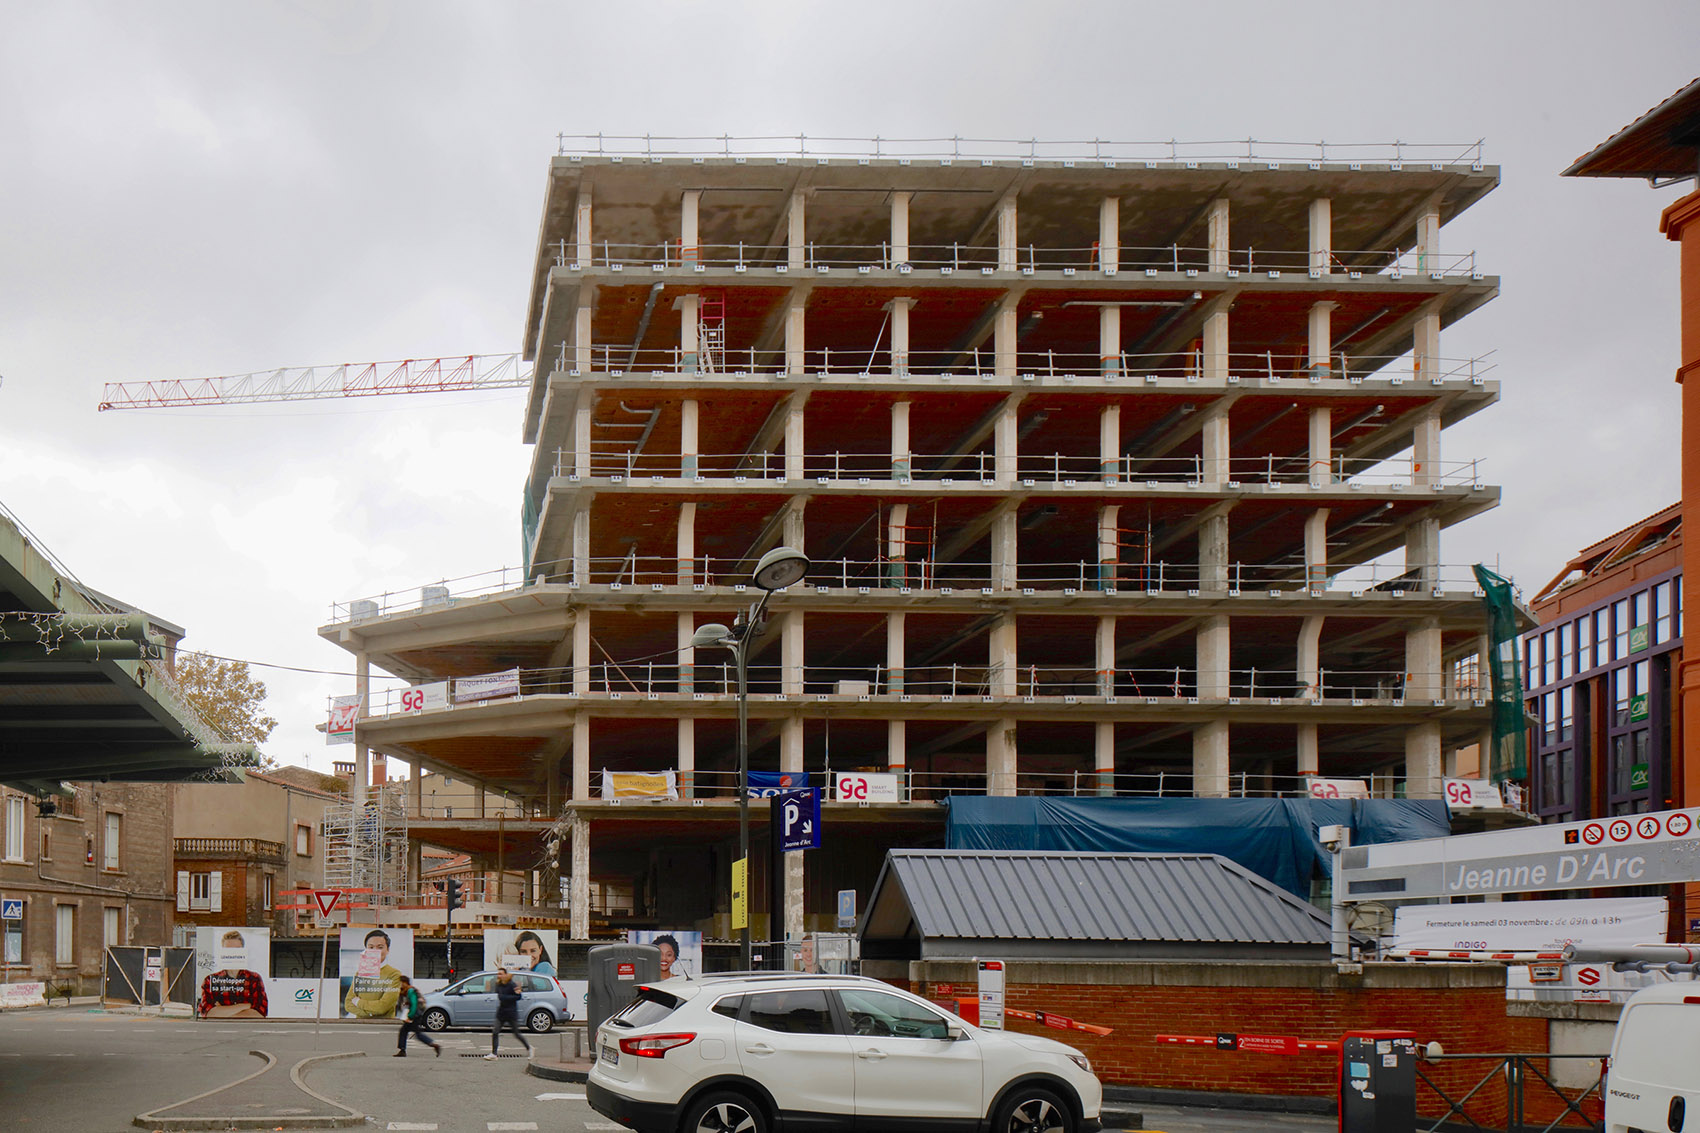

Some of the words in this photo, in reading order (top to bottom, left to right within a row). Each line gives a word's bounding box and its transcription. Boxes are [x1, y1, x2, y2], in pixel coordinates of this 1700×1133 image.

[784, 804, 799, 837] P
[1614, 826, 1627, 836] 15
[1450, 864, 1547, 891] Jeanne
[1556, 852, 1646, 883] D'Arc
[843, 896, 850, 913] P
[1462, 919, 1470, 927] le
[1470, 919, 1497, 927] samedi
[1498, 919, 1508, 927] 03
[1509, 918, 1549, 926] novembre
[1555, 917, 1567, 926] de
[1569, 916, 1588, 926] 09h
[1602, 916, 1621, 925] 13h
[1454, 940, 1488, 949] INDIGO
[212, 977, 246, 985] Développer
[355, 977, 371, 985] Faire
[372, 977, 393, 986] grandir
[220, 985, 245, 993] start-up
[1238, 1037, 1245, 1048] 2
[1610, 1089, 1641, 1101] PEUGEOT
